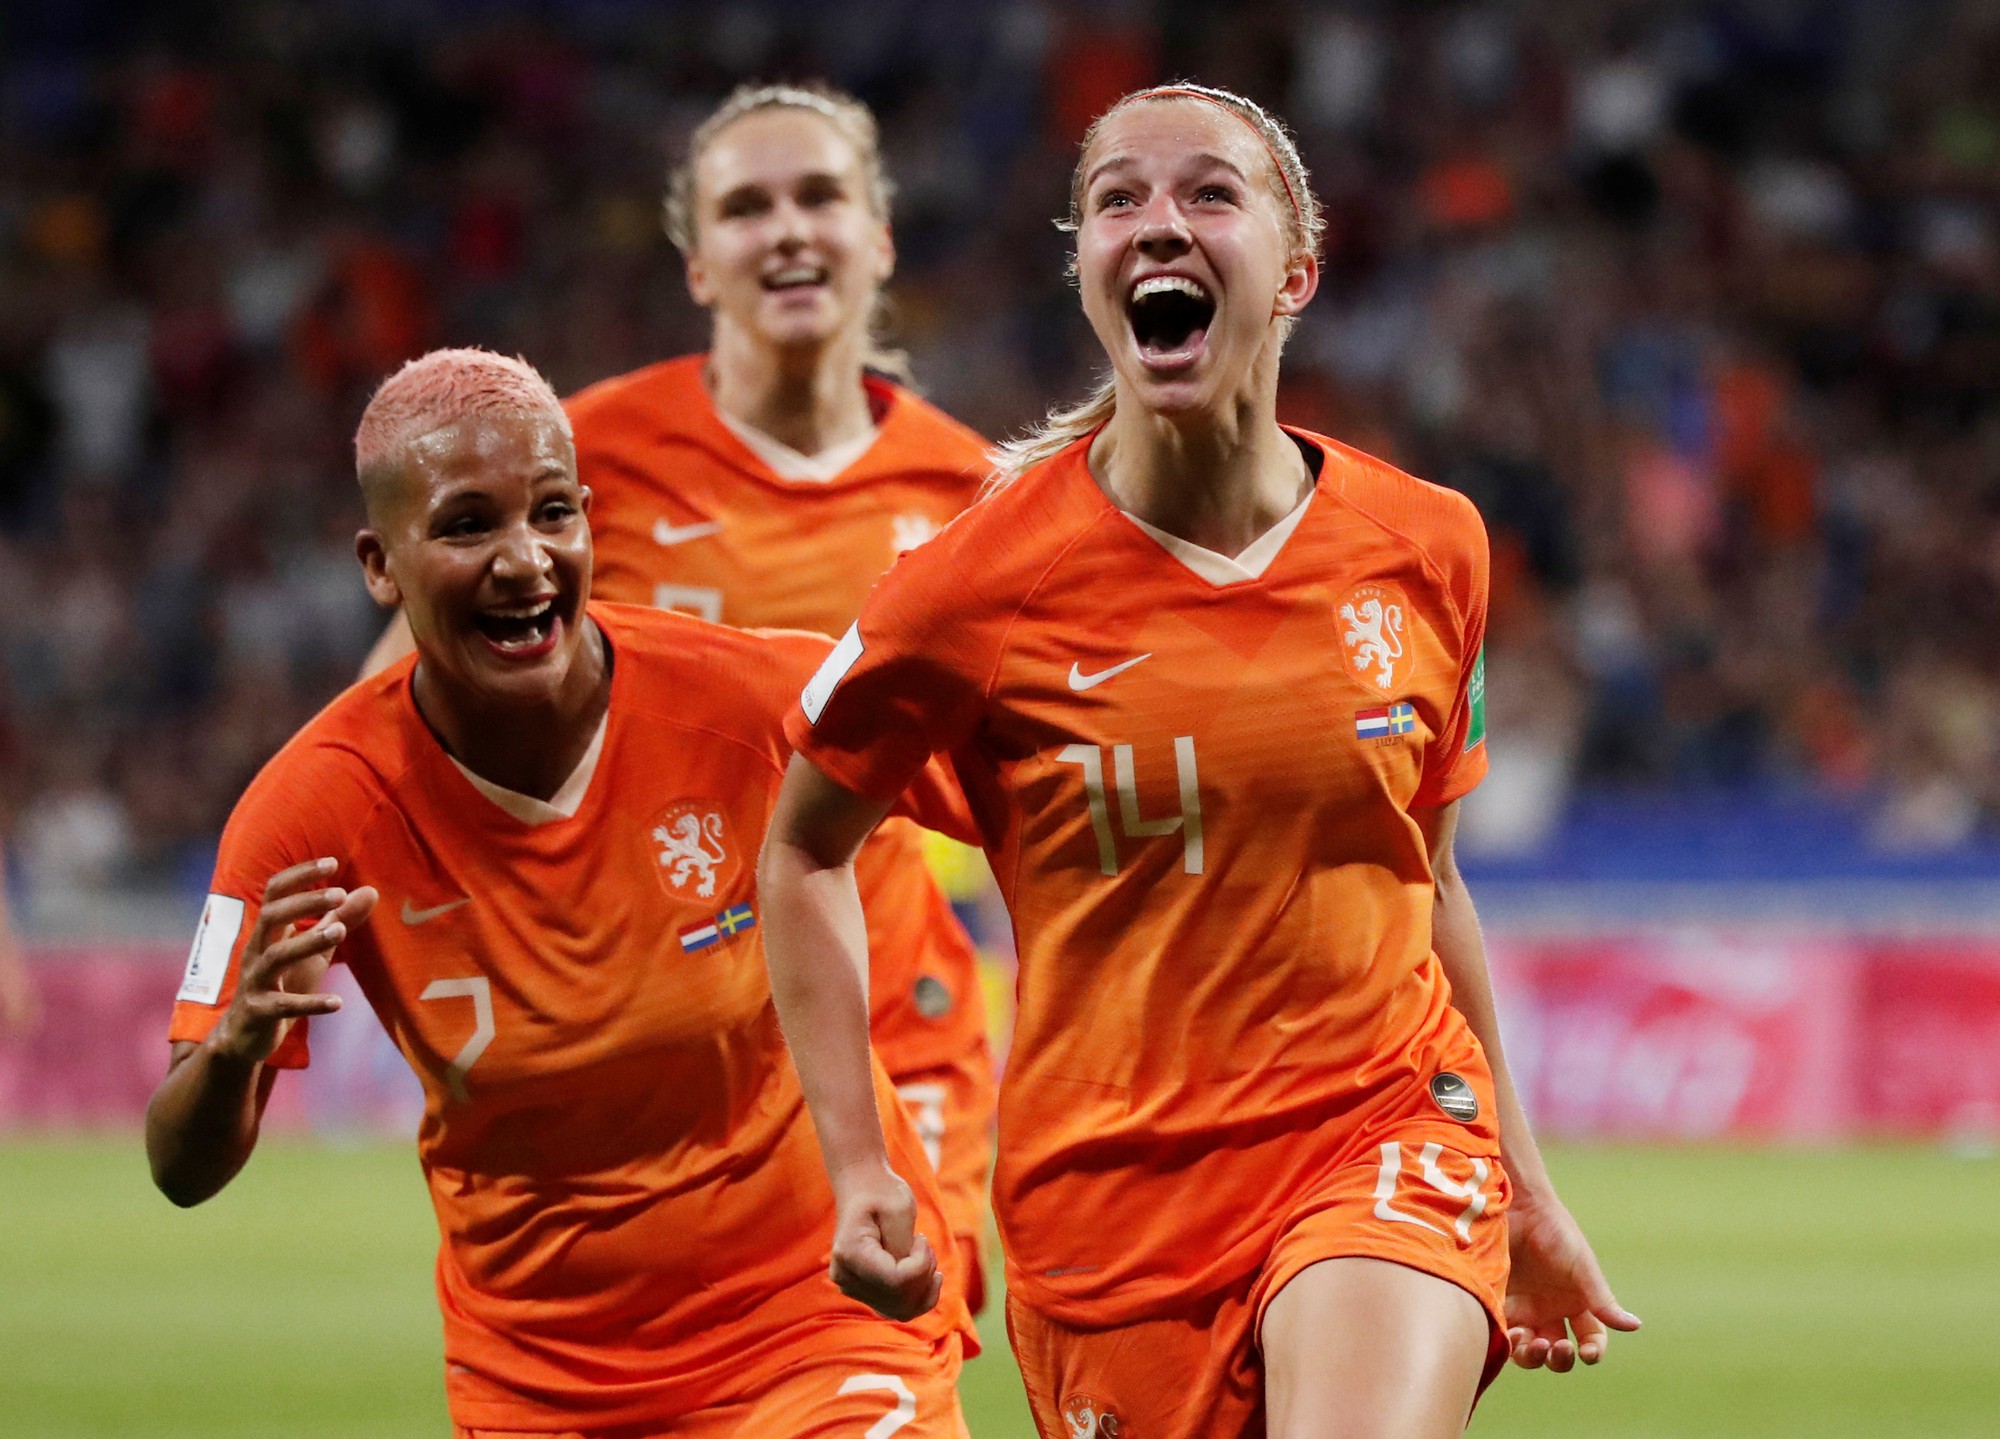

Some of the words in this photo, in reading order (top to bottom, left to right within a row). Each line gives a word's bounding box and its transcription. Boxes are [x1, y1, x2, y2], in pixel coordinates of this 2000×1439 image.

[1054, 735, 1204, 877] 14
[419, 976, 496, 1104] 7
[1373, 1141, 1488, 1243] 14
